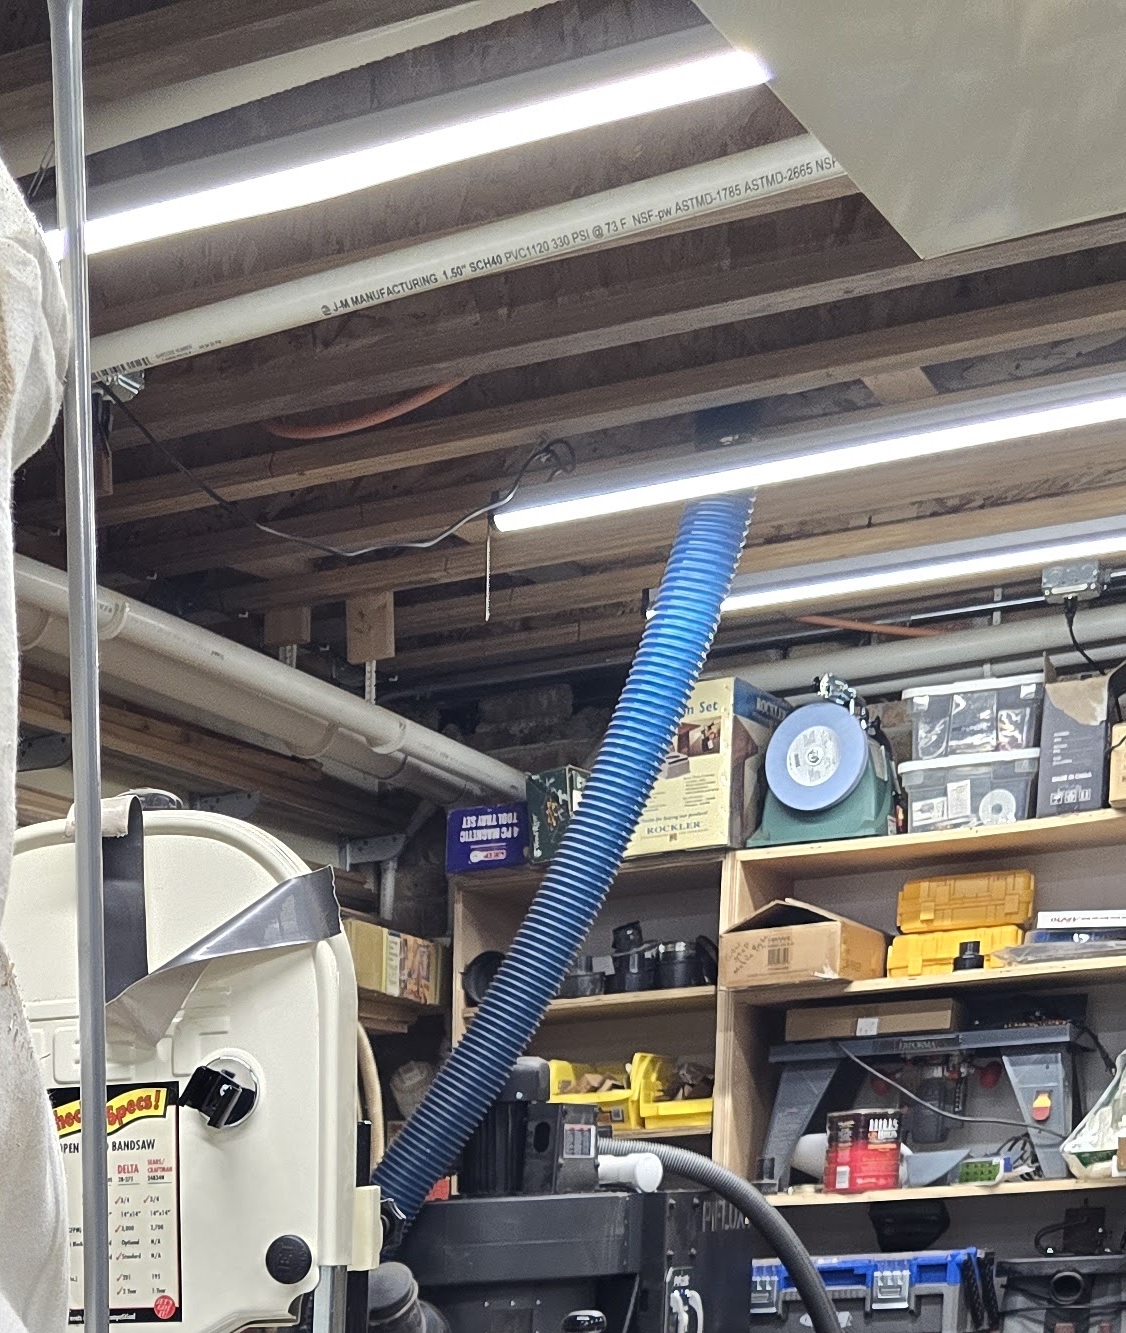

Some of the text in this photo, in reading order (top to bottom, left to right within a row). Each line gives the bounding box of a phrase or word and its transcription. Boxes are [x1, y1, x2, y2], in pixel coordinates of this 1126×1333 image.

[333, 296, 350, 312] J-M
[350, 273, 438, 306] MANUFACTURING
[442, 264, 467, 281] 1.50"
[469, 254, 502, 273] SCH40
[504, 239, 550, 262] PVC1120
[551, 235, 570, 250] 330
[571, 228, 590, 245] PSI
[591, 225, 604, 239] @
[604, 220, 619, 234] 73
[620, 217, 627, 230] F
[632, 207, 672, 227] NSF-pw
[675, 184, 742, 214] ASTMD-1785
[744, 162, 813, 194] ASTMD-2665
[699, 701, 718, 713] Set
[462, 812, 518, 829] TOOL TRAY SET
[647, 821, 701, 834] ROCKLER
[460, 828, 501, 843] MAGNETIC
[106, 1089, 161, 1126] Specs!
[112, 1139, 155, 1151] BANDSAW
[117, 1164, 139, 1174] DELTA
